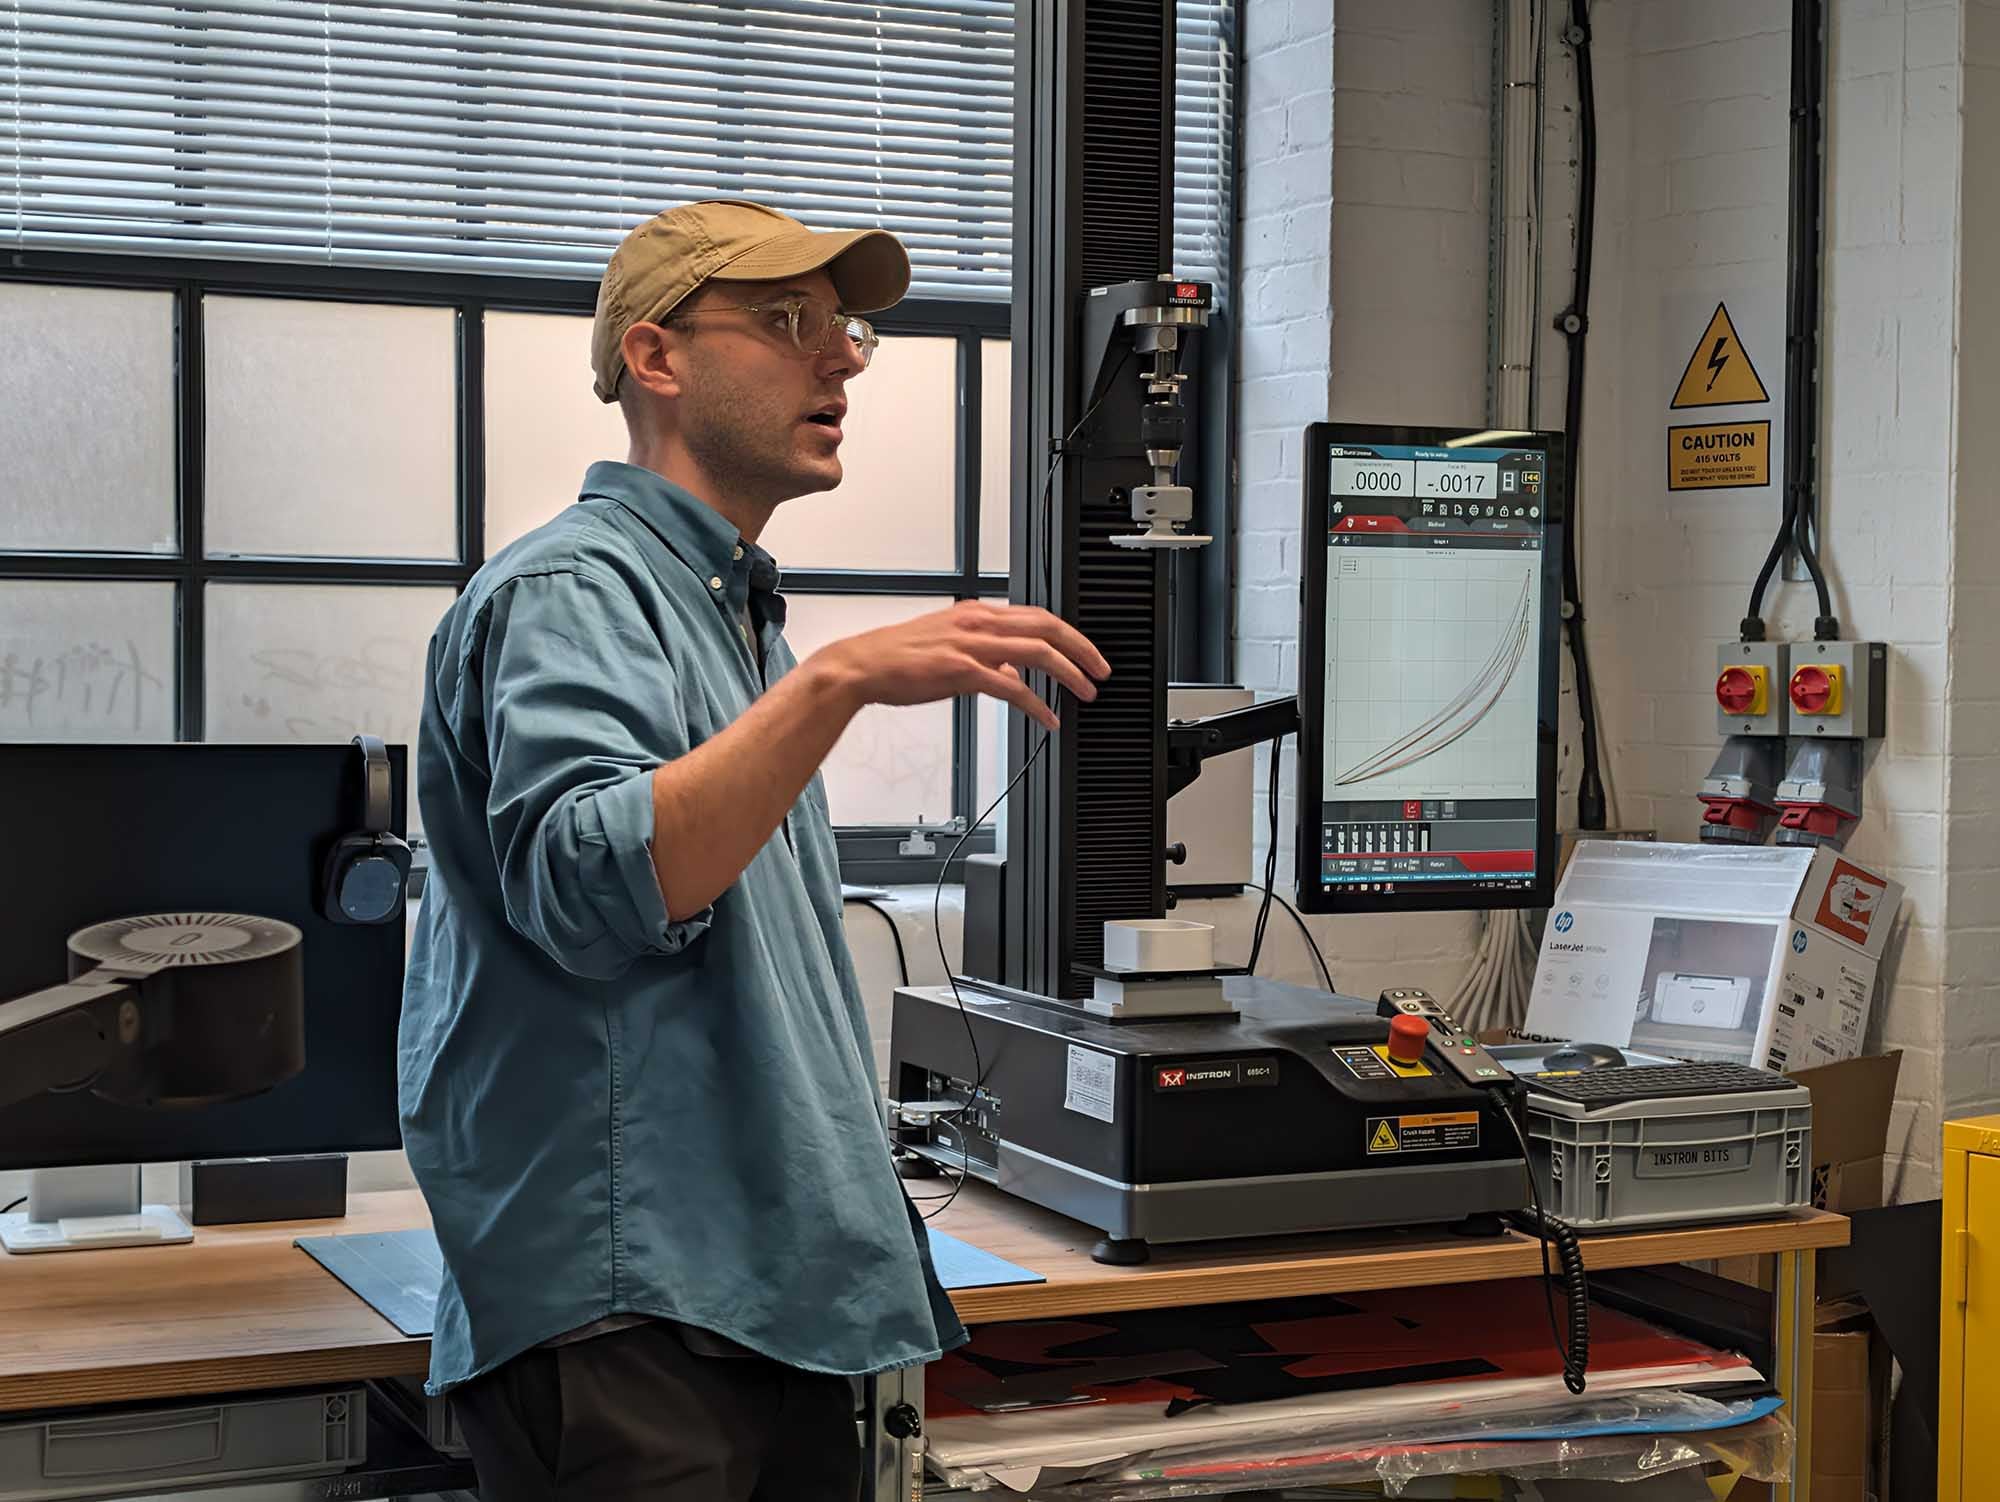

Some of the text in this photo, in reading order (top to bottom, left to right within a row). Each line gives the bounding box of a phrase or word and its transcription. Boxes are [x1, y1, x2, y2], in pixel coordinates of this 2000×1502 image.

[1682, 432, 1755, 450] CAUTION
[1695, 453, 1741, 463] 415 VOLTS
[1351, 472, 1401, 491] .0000
[1720, 782, 1731, 794] 2
[1555, 911, 1574, 933] hp
[1549, 942, 1584, 952] LaserJet
[1792, 929, 1808, 954] hp
[1186, 1070, 1231, 1080] INSTRON
[1654, 1149, 1729, 1166] INSTRON BITS
